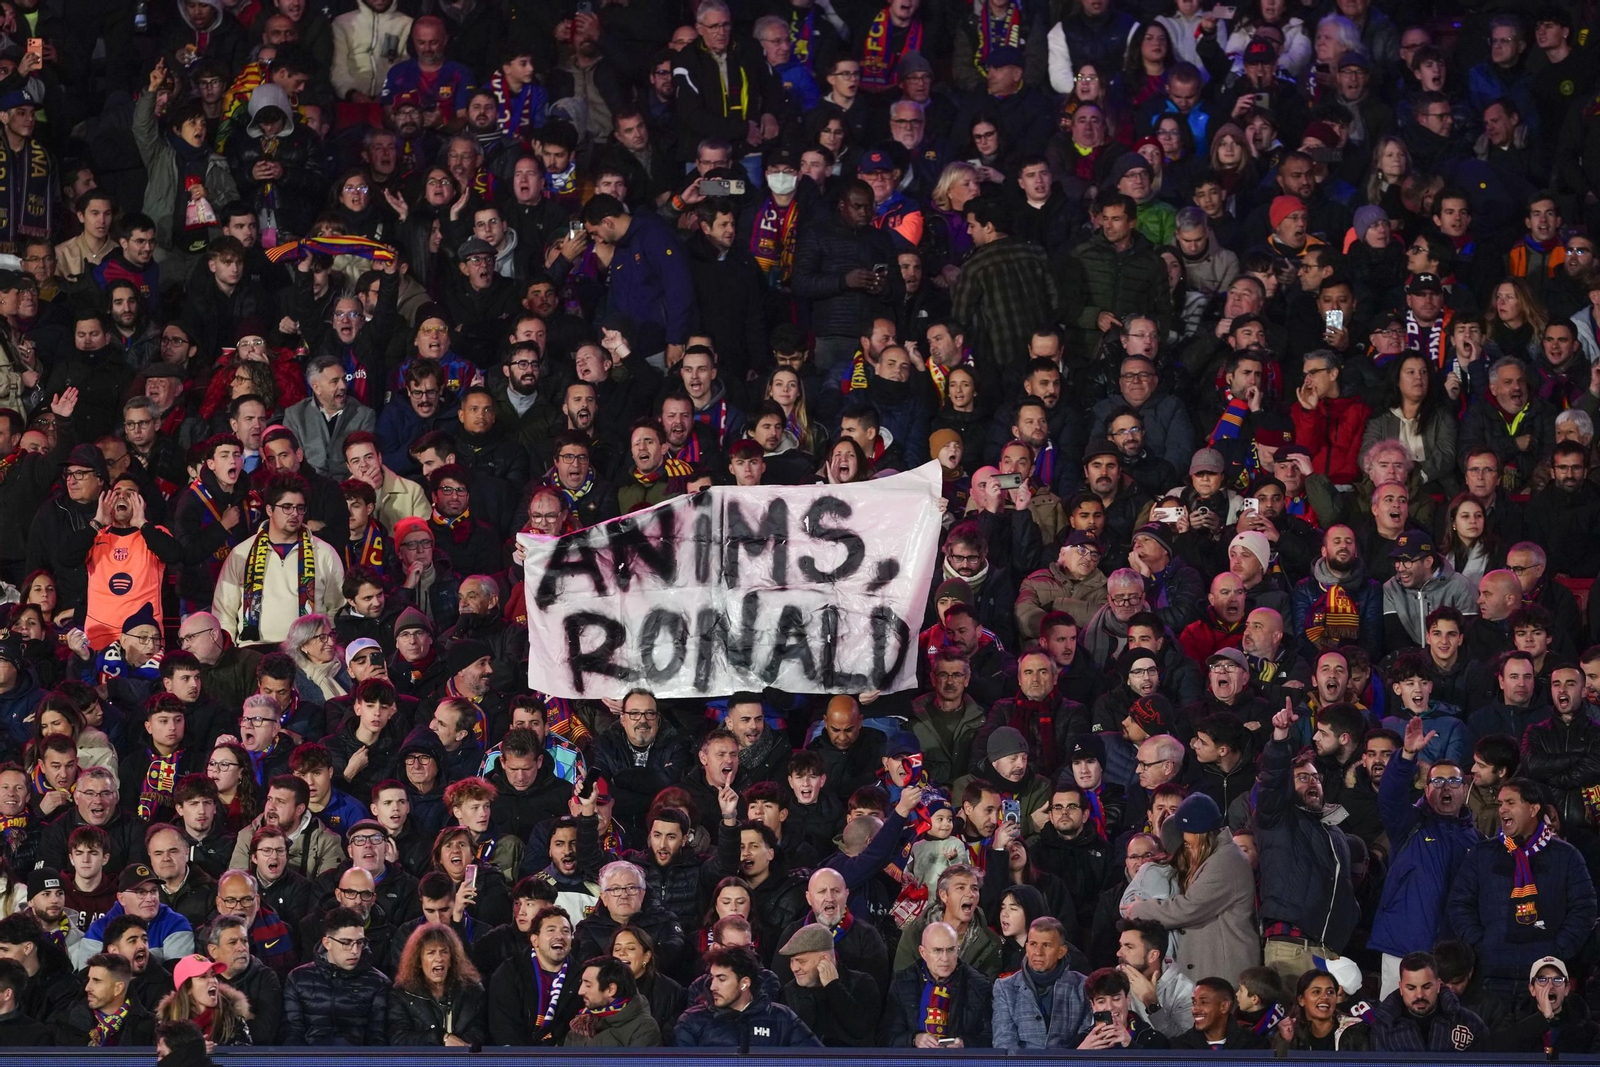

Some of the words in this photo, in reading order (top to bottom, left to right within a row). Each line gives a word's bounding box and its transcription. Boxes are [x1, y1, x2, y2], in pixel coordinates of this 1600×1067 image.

[536, 486, 900, 611] ANIMS,
[563, 591, 910, 694] RONALD
[753, 1026, 771, 1037] HH
